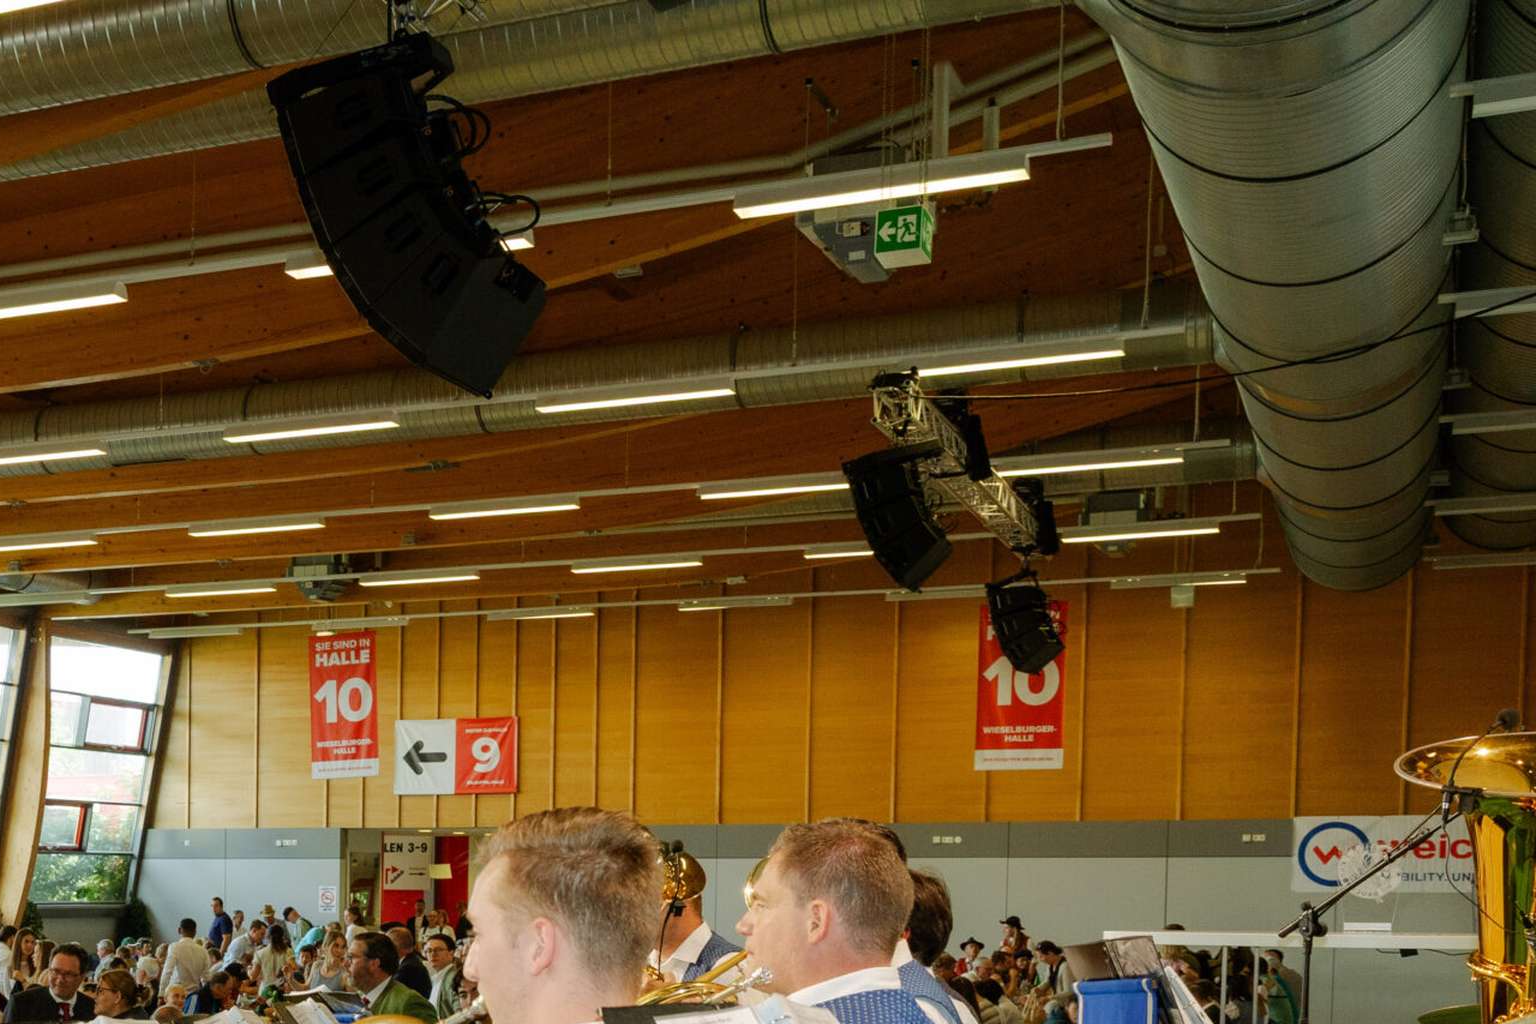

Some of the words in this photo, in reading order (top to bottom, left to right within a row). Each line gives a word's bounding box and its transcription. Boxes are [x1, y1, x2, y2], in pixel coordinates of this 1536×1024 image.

[315, 641, 331, 651] SIE
[333, 639, 357, 649] SIND
[360, 638, 370, 647] IN
[315, 649, 370, 667] HALLE
[982, 655, 1060, 706] 10
[314, 677, 373, 723] 10
[1004, 734, 1034, 743] HALLE
[471, 736, 502, 774] 9
[407, 843, 428, 853] 3-9
